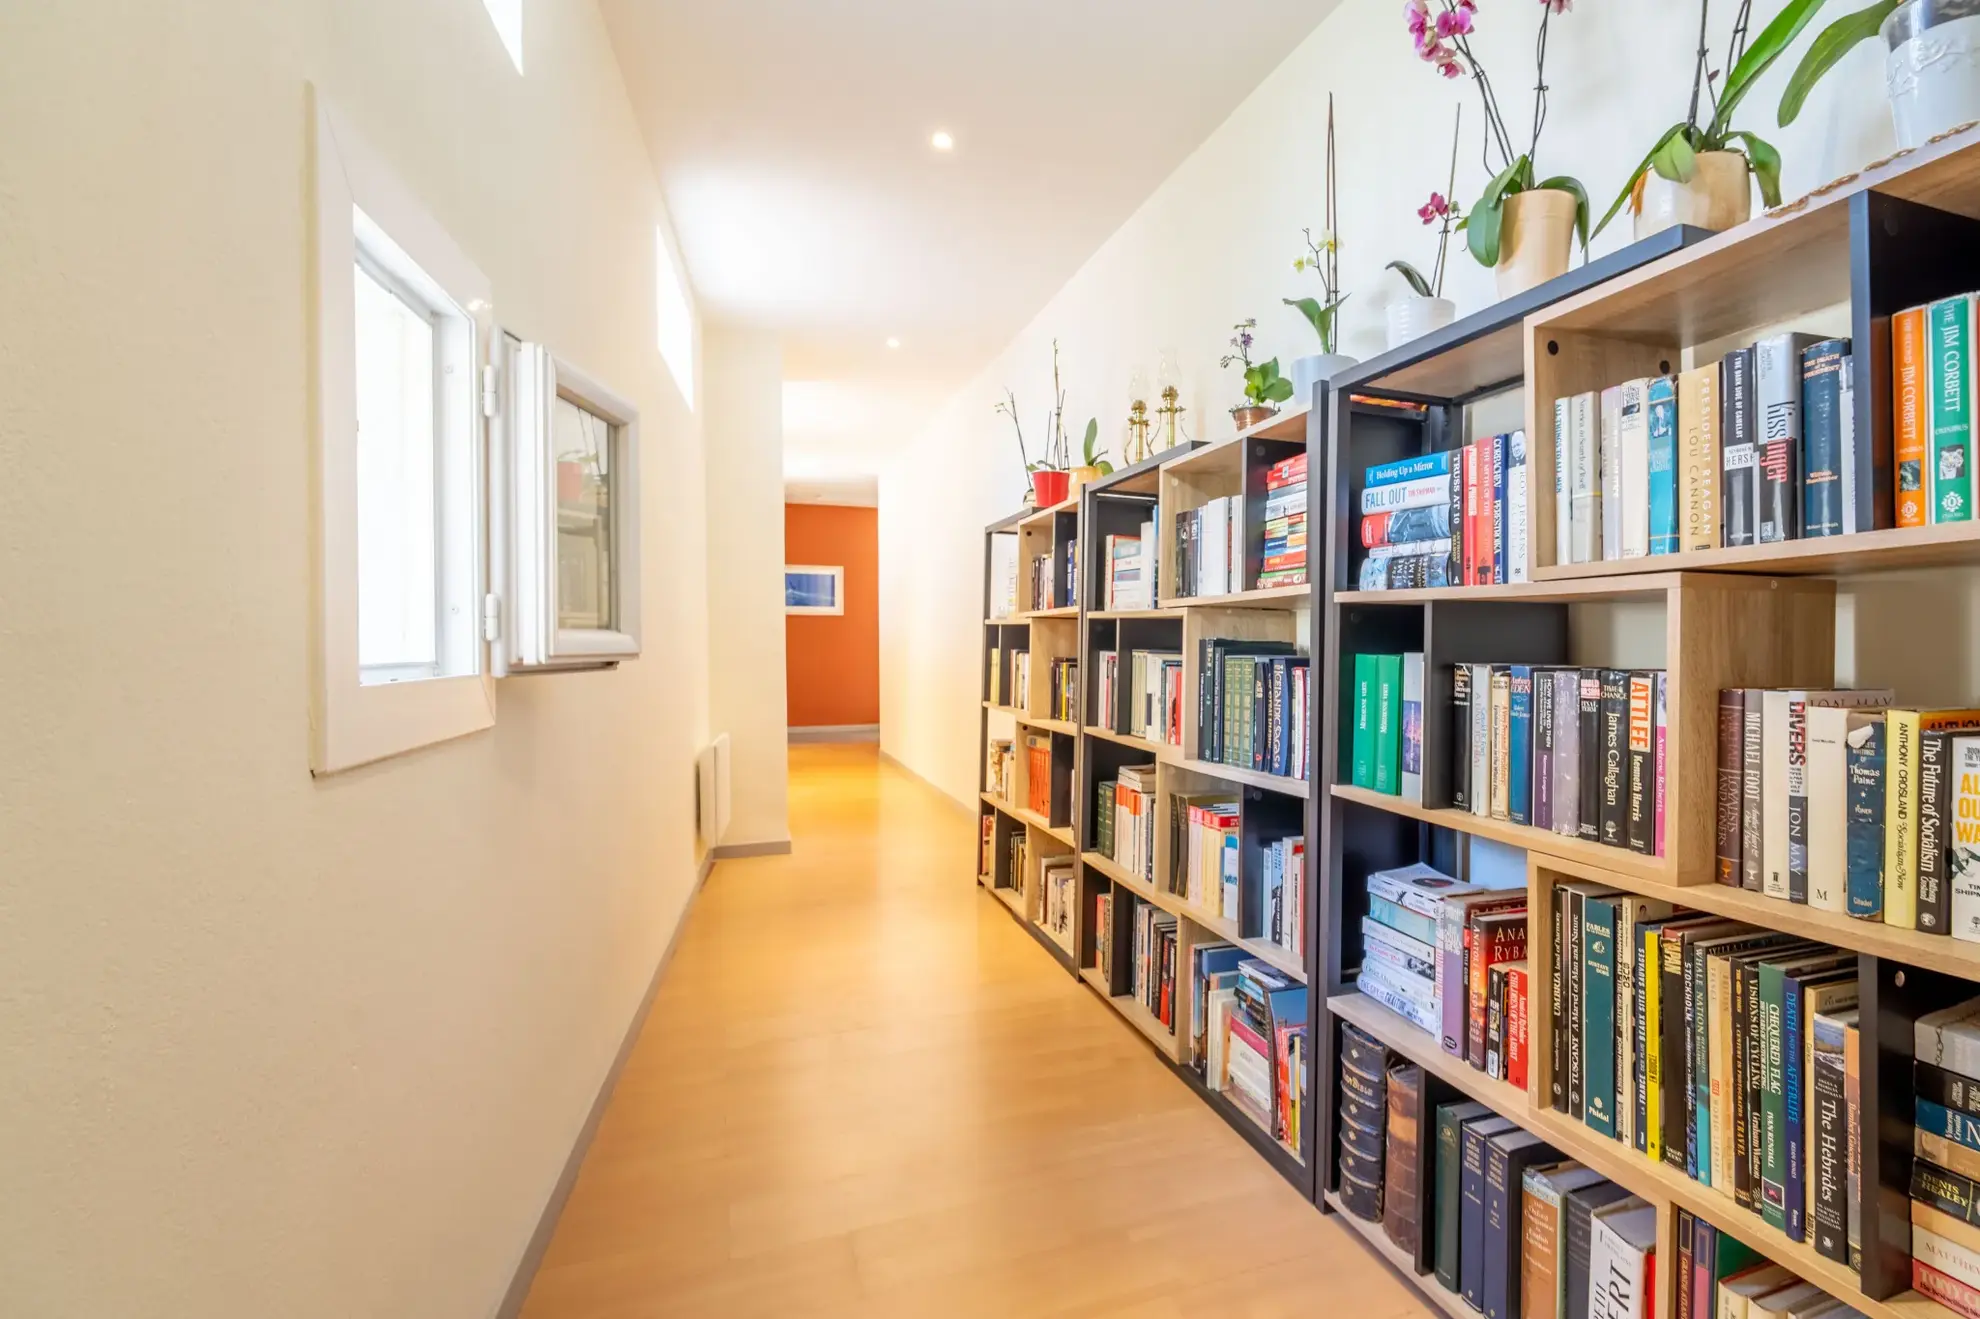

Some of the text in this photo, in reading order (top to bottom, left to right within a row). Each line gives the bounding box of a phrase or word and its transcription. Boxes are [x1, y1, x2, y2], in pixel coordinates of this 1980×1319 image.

[1940, 324, 1960, 348] JIM
[1734, 357, 1742, 369] THE
[1943, 350, 1961, 412] CORBETT
[1734, 401, 1742, 409] OF
[1901, 364, 1917, 439] JIM CORBETT
[1734, 410, 1743, 438] CAMELOT
[1376, 468, 1398, 480] Holding
[1400, 466, 1409, 476] Up
[1414, 461, 1434, 472] Mirror
[1701, 378, 1712, 534] PRESIDENT REAGAN
[1453, 454, 1461, 524] TRUSS AT 10
[1689, 428, 1699, 536] LOU CANNON
[1366, 491, 1386, 509] FALL
[1388, 487, 1408, 504] OUT
[1518, 504, 1526, 560] JENKINS
[1511, 685, 1531, 693] EDEN
[1601, 692, 1628, 700] CHANGE
[1546, 699, 1551, 710] WE
[1631, 682, 1650, 748] ATTLEE
[1789, 701, 1806, 766] DIVERS
[1605, 712, 1621, 806] James Callaghan
[1745, 712, 1761, 802] MICHAEL FOOT
[1849, 764, 1880, 777] Thomas
[1632, 755, 1643, 822] Kenneth Harris
[1853, 775, 1876, 785] Paine
[1960, 773, 1980, 795] AL
[1728, 776, 1741, 833] LOYALISTS
[1896, 722, 1908, 891] ANTHONY CROSLAND Socialism Now
[1920, 739, 1942, 873] The Future of Socialism
[1958, 797, 1980, 819] OU
[1719, 802, 1729, 846] LONERS
[1955, 820, 1980, 843] WA
[1789, 807, 1801, 876] JON MAY
[1816, 889, 1828, 901] M
[1853, 897, 1873, 908] Citadel
[1920, 876, 1928, 901] Crosland
[1927, 876, 1939, 903] Anthony
[1554, 911, 1562, 943] harmony
[1571, 914, 1579, 943] Nature
[1586, 922, 1611, 935] FABLES
[1472, 925, 1481, 968] ANATOLI
[1494, 946, 1528, 962] RYBA
[1571, 945, 1579, 960] and
[1571, 962, 1579, 980] Man
[1623, 962, 1631, 989] SUMO
[1638, 948, 1646, 987] SAUVAGES
[1510, 972, 1518, 1009] CHILDREN
[1553, 972, 1561, 1017] UMBRIA
[1571, 982, 1579, 993] of
[1638, 989, 1646, 1011] SITES
[1684, 962, 1693, 1021] STOCKHOLM
[1694, 949, 1705, 1033] WHALE NATION
[1571, 994, 1579, 1023] Marvel
[1786, 992, 1796, 1030] DEATH
[1510, 1020, 1518, 1033] THE
[1638, 1012, 1646, 1042] BEAUX
[1749, 979, 1760, 1090] VISIONS OF CYCLING
[1510, 1033, 1518, 1061] ARBAT
[1571, 1036, 1579, 1085] TUSCANY
[1769, 1004, 1781, 1095] CHEQUERED FLAG
[1638, 1074, 1647, 1105] FRANCE
[1788, 1064, 1798, 1123] AFTERLIFE
[1588, 1106, 1610, 1123] Phidal
[1944, 1110, 1953, 1138] Vincent
[1954, 1114, 1962, 1141] Cronin
[1736, 1120, 1746, 1157] TRAVEL
[1752, 1112, 1761, 1180] Graham Watson
[1767, 1111, 1775, 1169] IVAN RENDALL
[1821, 1100, 1837, 1202] The Hebrides
[1848, 1102, 1857, 1176] Bamber Gascoigne
[1921, 1180, 1968, 1207] HEALEY
[1922, 1172, 1960, 1195] DENIS
[1608, 1260, 1631, 1319] ERT
